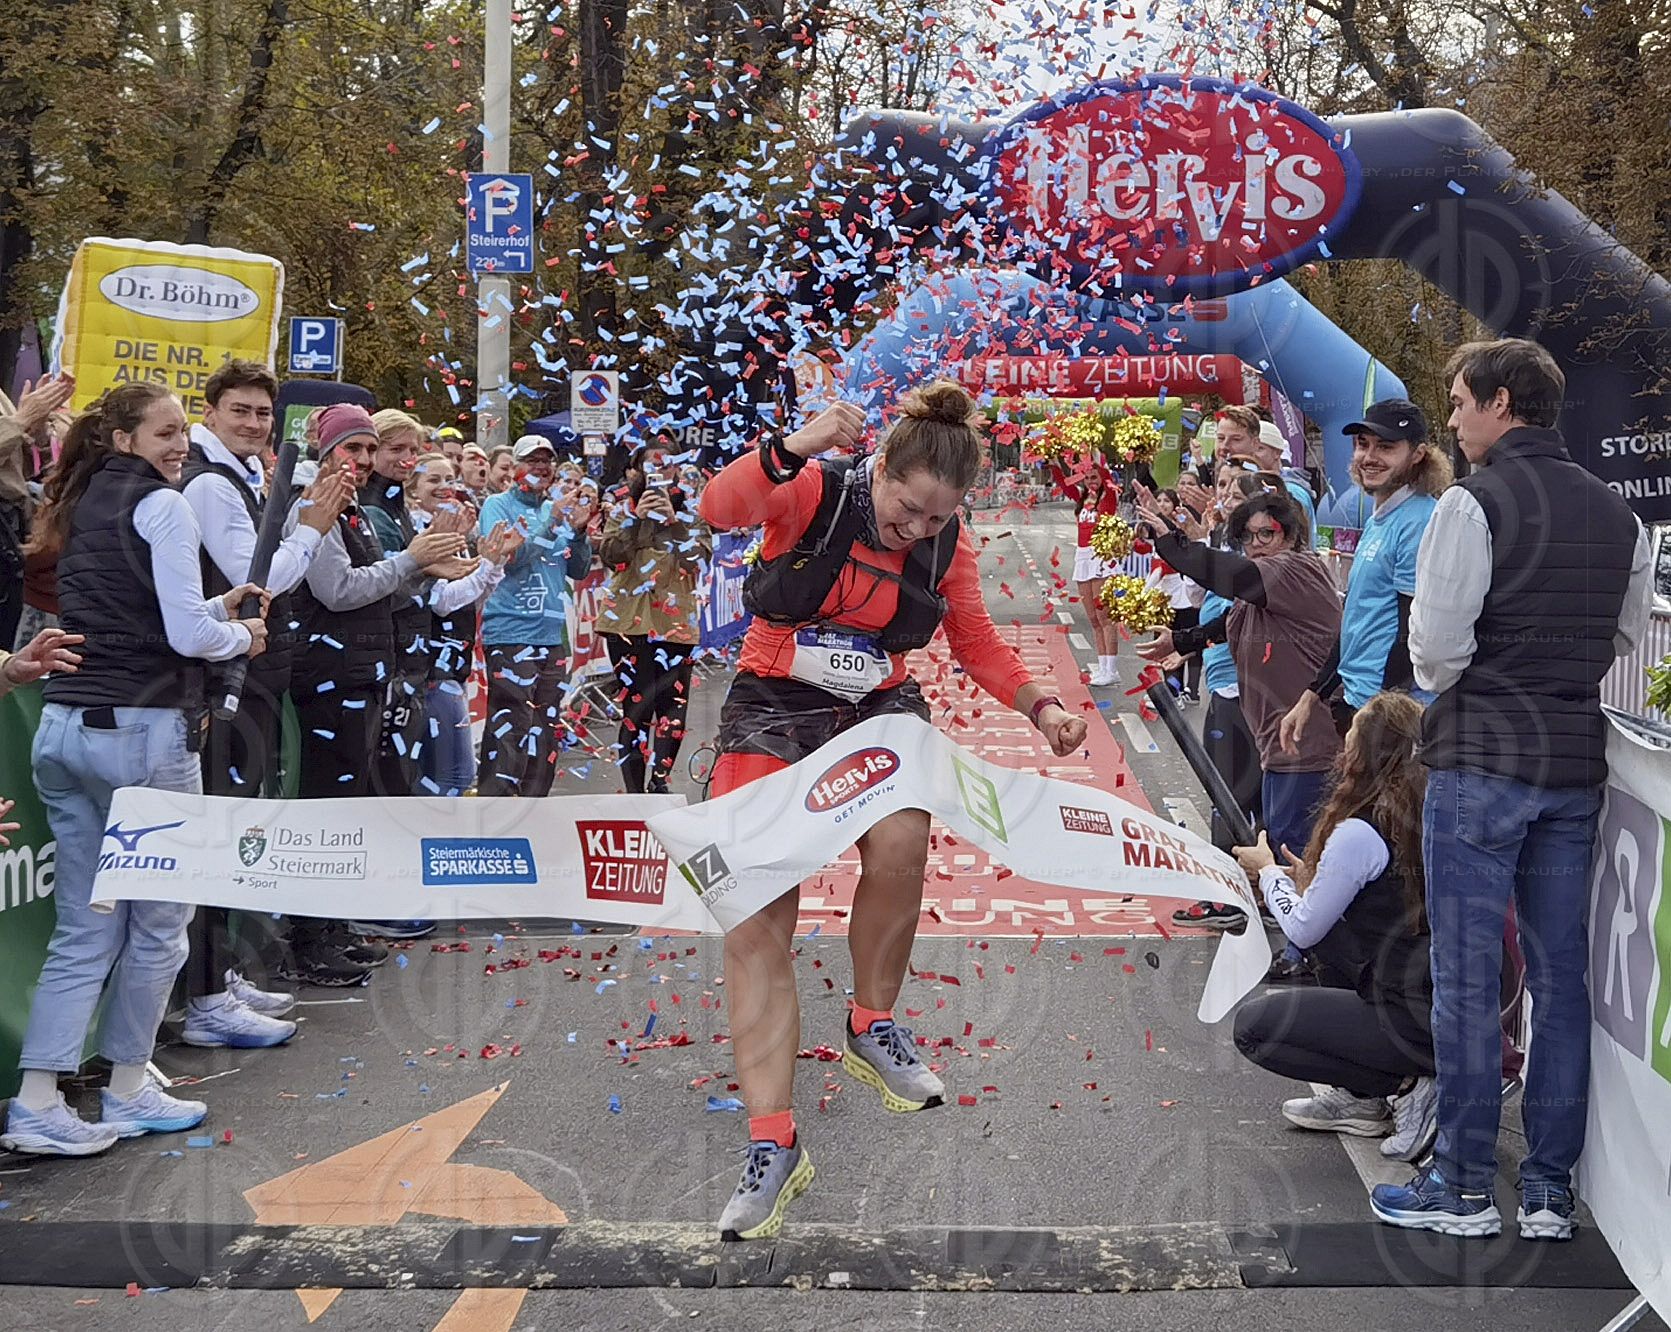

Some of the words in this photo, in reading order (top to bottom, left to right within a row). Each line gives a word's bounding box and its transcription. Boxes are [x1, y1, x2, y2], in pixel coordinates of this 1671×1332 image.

[1027, 125, 1327, 242] Hervis
[470, 233, 530, 247] Steirerhof
[113, 277, 155, 300] Dr.
[300, 321, 326, 352] P
[114, 340, 159, 362] DIE
[166, 345, 210, 368] NR.
[113, 364, 168, 385] AUS
[176, 370, 210, 392] DE
[961, 358, 1071, 386] LEINE
[1083, 354, 1218, 386] ZEITUNG
[830, 653, 864, 671] 650
[822, 678, 864, 690] Magdalena
[811, 754, 893, 807] Hervis
[834, 806, 854, 824] GET
[1062, 807, 1108, 822] KLEINE
[1065, 819, 1112, 834] ZEITUNG
[1121, 816, 1188, 855] GRAZ
[278, 828, 313, 846] Das
[320, 827, 364, 846] Land
[429, 847, 510, 860] Steiermärkische
[267, 856, 363, 875] Steiermark
[429, 860, 513, 876] SPARKASSE
[696, 850, 723, 883] Z
[248, 877, 278, 890] Sport
[590, 861, 664, 895] ZEITUNG
